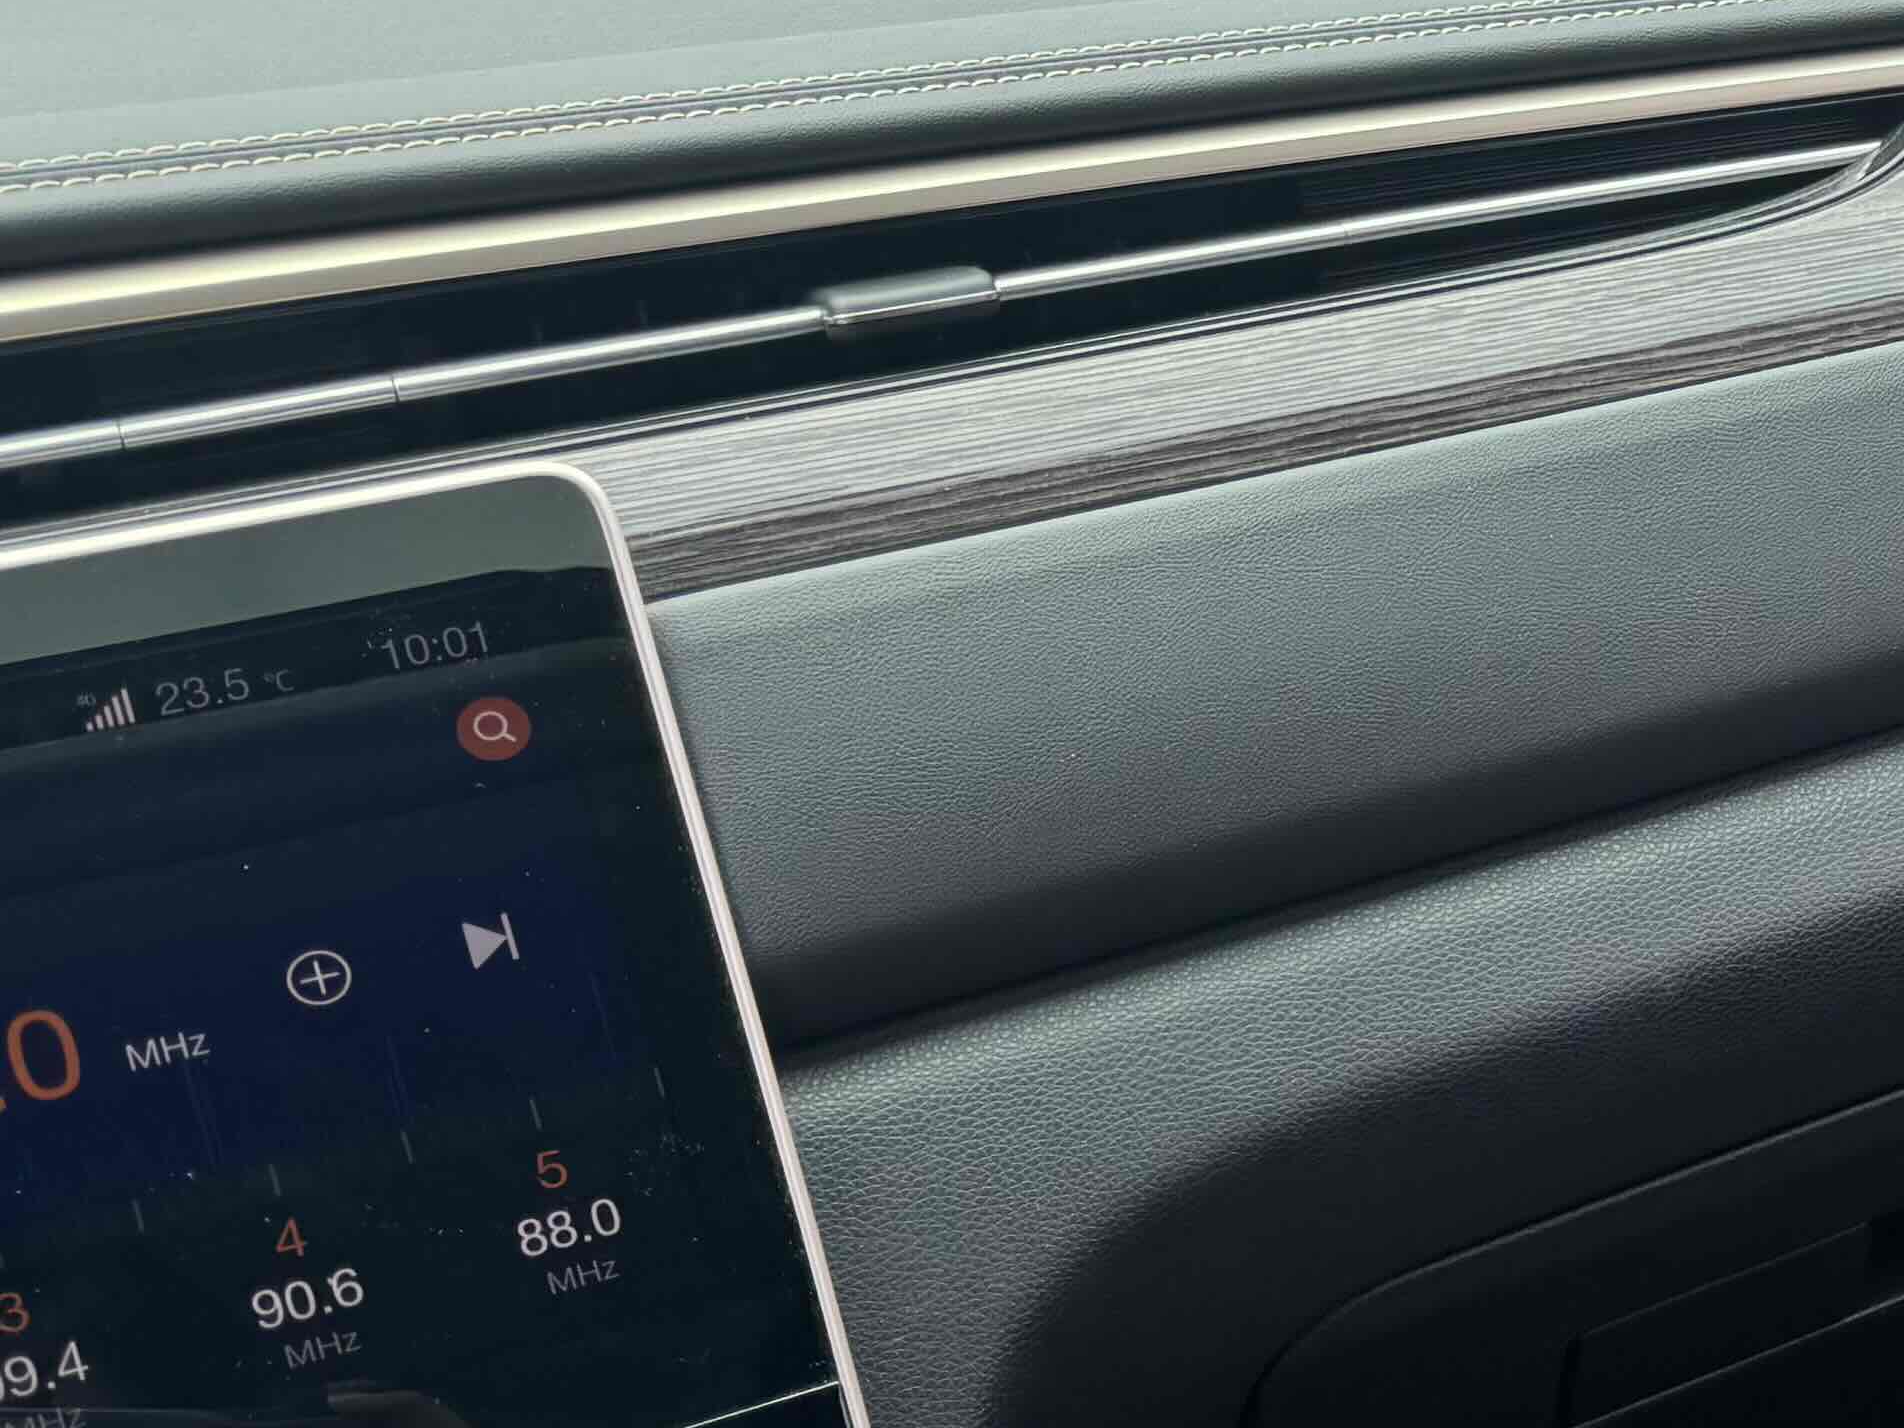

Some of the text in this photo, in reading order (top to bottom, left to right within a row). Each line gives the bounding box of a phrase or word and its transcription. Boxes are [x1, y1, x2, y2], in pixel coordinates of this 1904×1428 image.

[380, 621, 489, 670] 10:01
[155, 668, 250, 717] 23.5
[125, 1031, 210, 1072] MHz
[536, 1150, 569, 1190] 5
[275, 1217, 307, 1257] 4
[517, 1198, 621, 1257] 88.0
[252, 1267, 364, 1329] 90.6
[546, 1260, 621, 1295] MHz
[0, 1340, 89, 1403] 9.4
[284, 1331, 362, 1370] MHz
